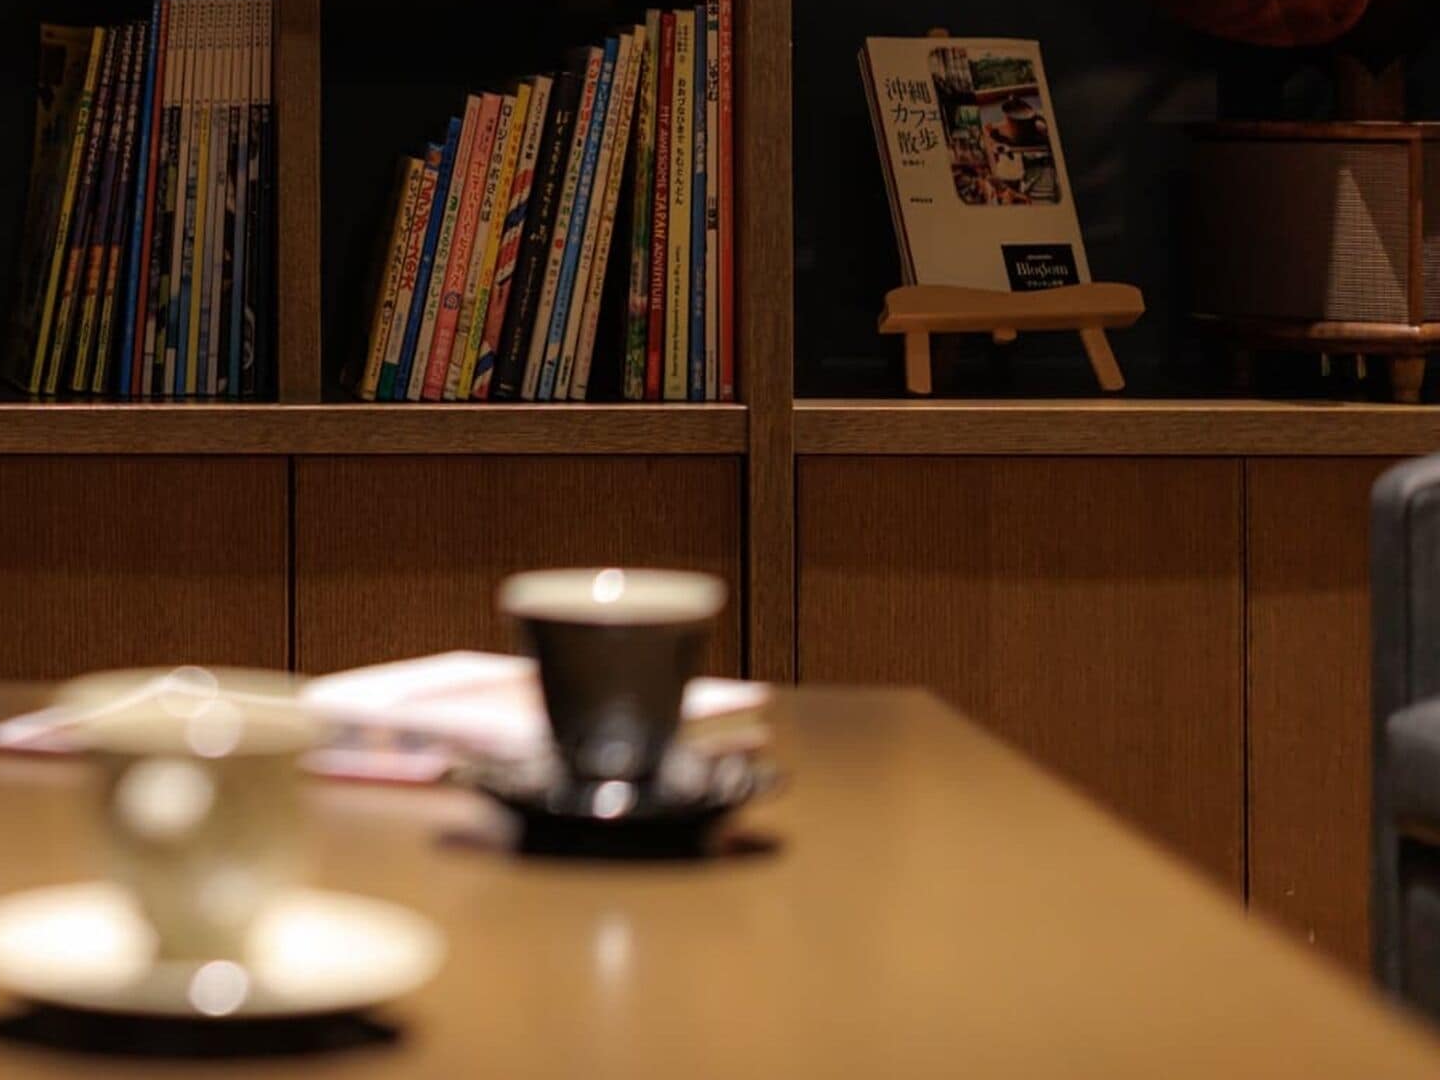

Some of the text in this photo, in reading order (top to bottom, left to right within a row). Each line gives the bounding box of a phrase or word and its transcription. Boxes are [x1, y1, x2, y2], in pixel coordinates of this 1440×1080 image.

[885, 77, 931, 104] 沖縄
[892, 102, 940, 126] カフェ
[897, 129, 939, 154] 散歩
[653, 193, 668, 240] JAPAN
[650, 241, 666, 312] ADVENTURE
